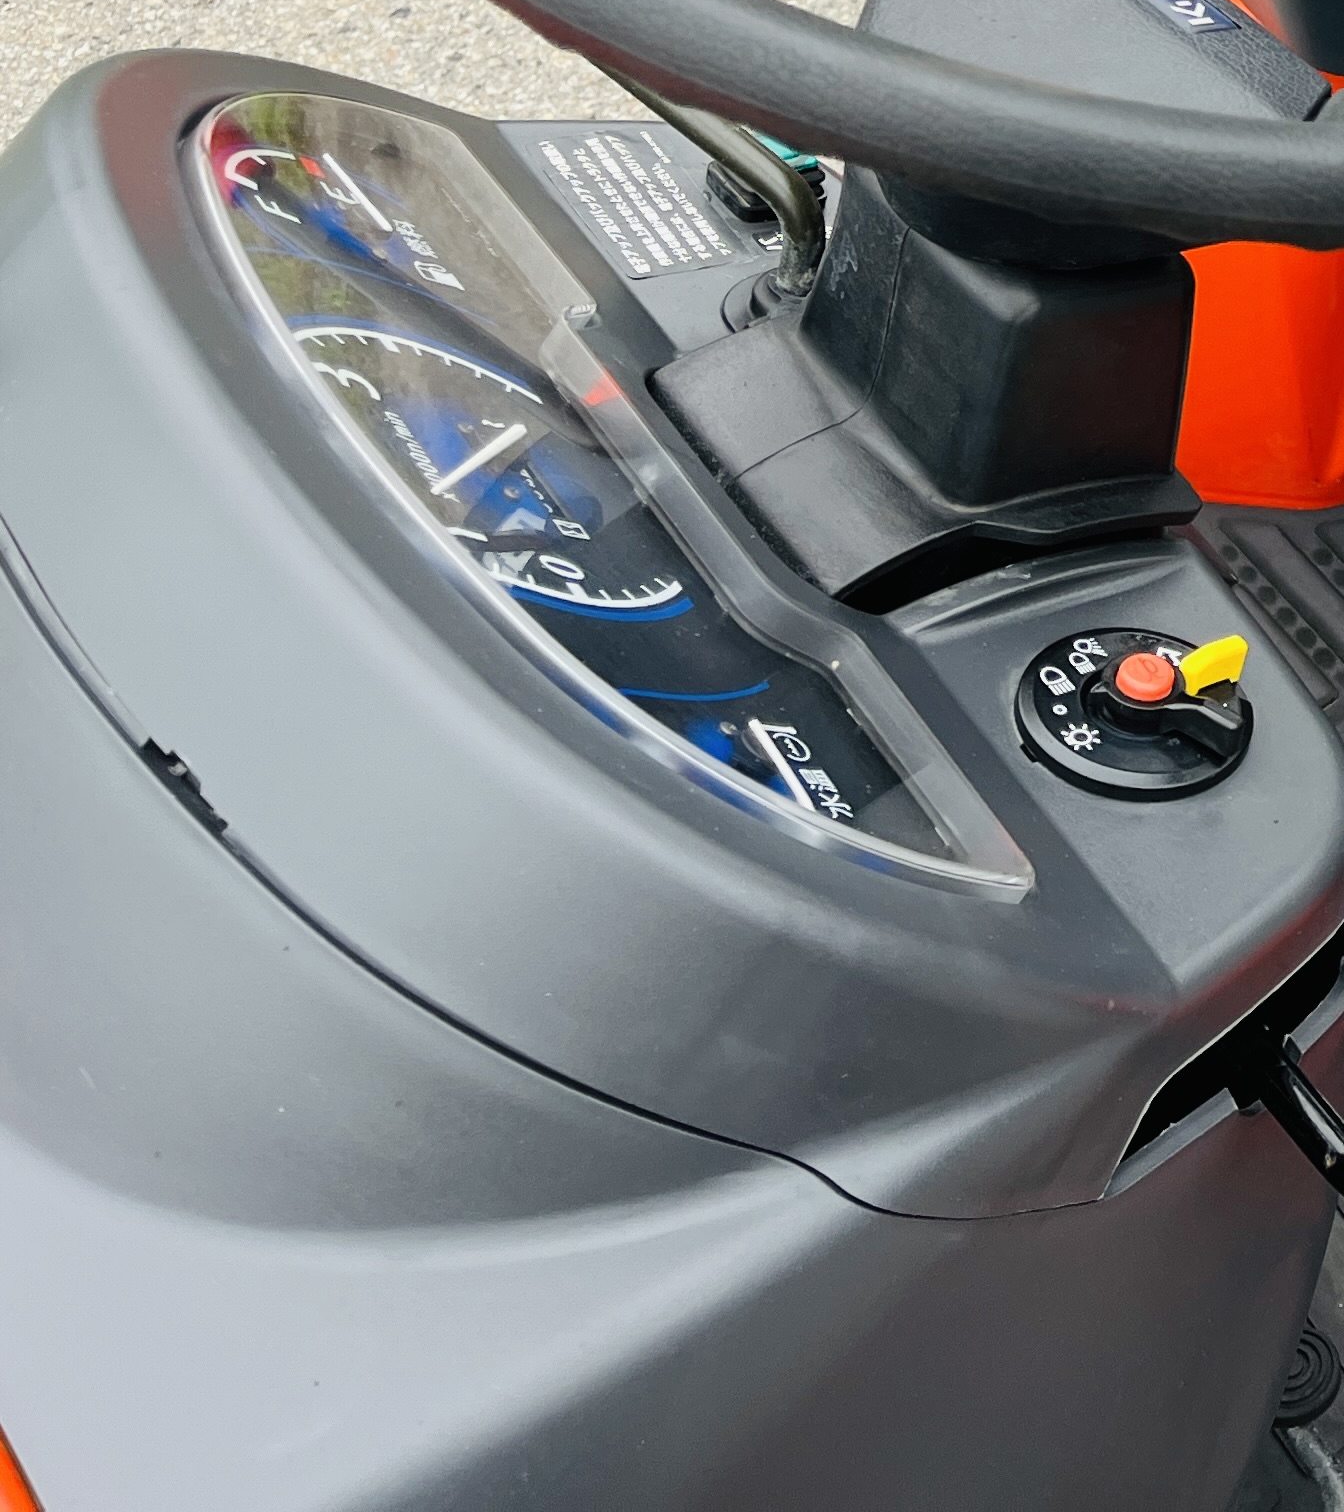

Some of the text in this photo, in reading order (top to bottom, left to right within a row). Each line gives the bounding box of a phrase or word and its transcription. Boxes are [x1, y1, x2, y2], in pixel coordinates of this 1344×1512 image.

[321, 180, 361, 209] E
[261, 198, 303, 224] F
[317, 362, 382, 402] 3
[539, 553, 586, 580] 0
[799, 764, 855, 820] 水温
